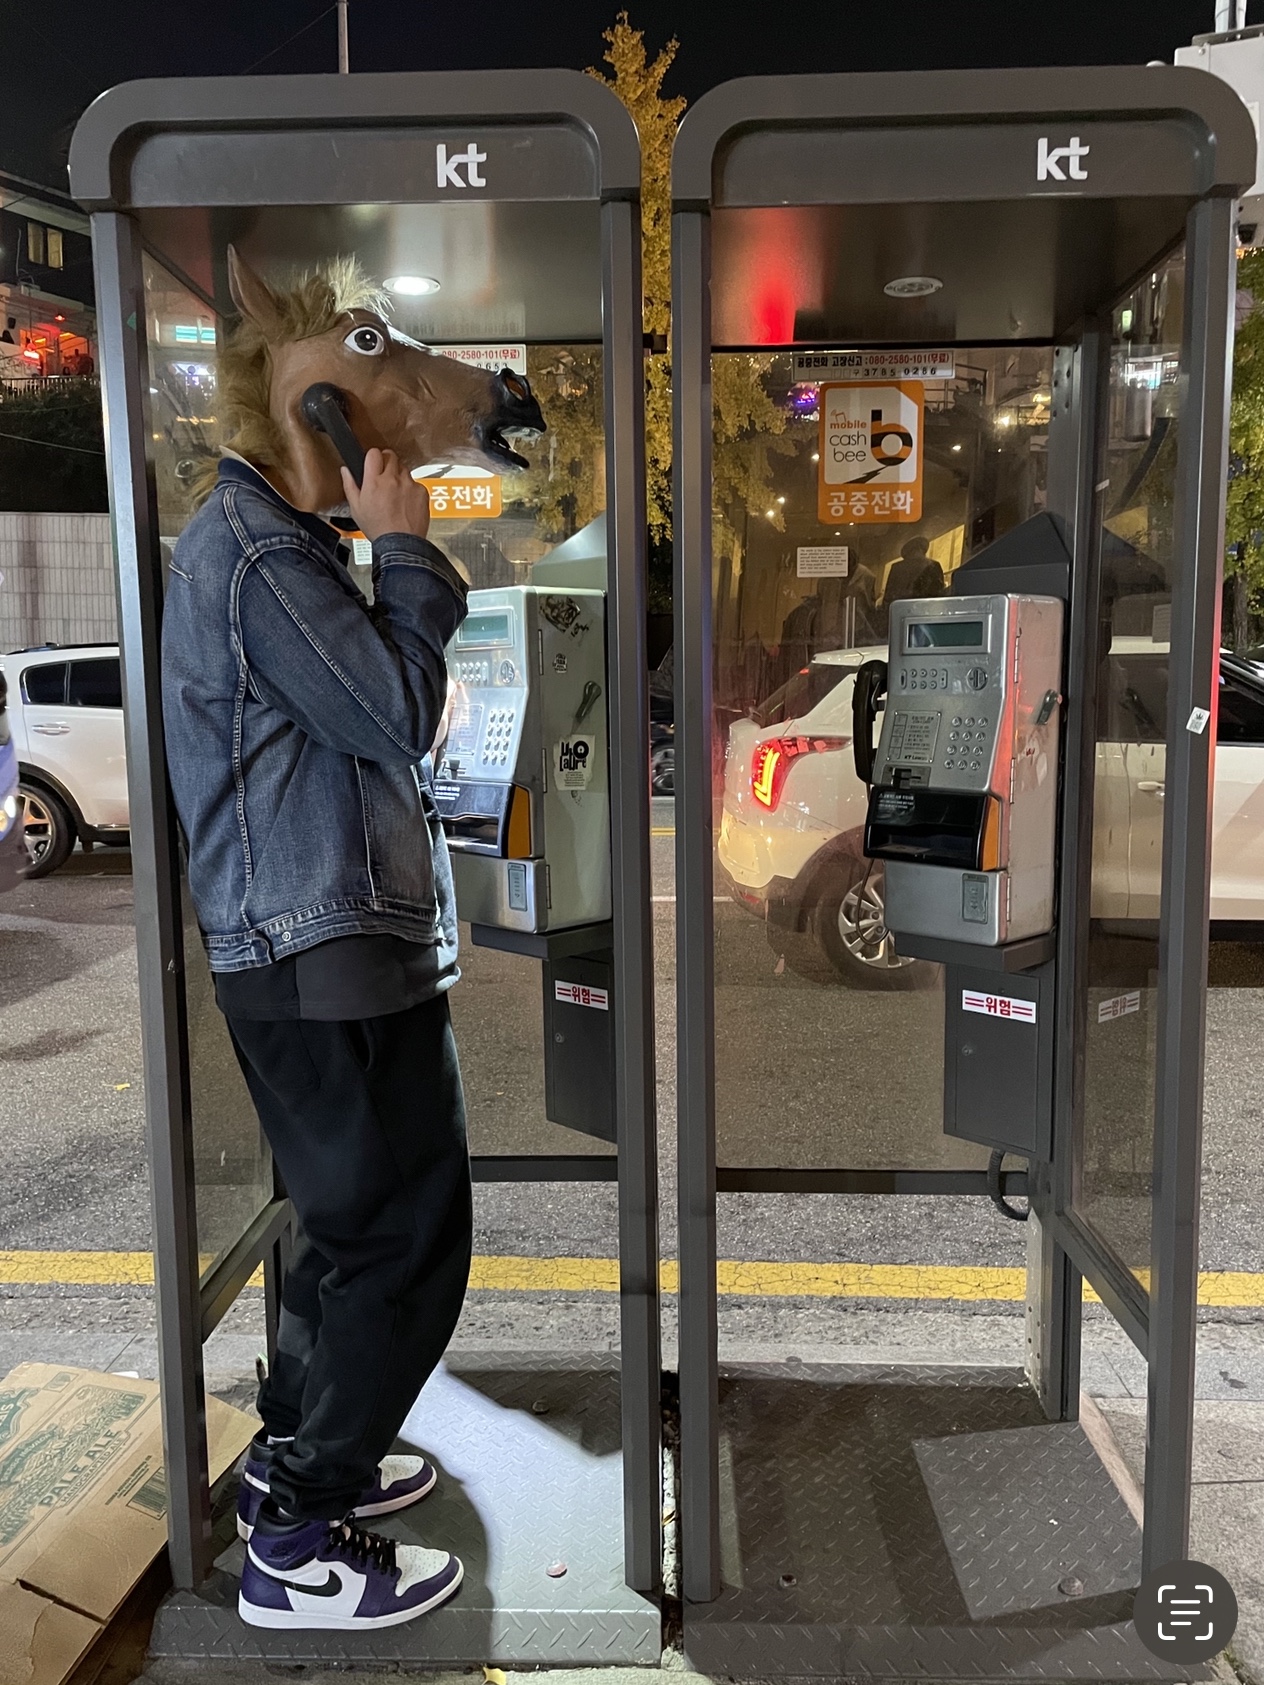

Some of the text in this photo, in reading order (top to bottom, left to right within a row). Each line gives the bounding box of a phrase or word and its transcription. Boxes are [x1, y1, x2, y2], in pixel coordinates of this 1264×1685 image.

[436, 143, 487, 188] kt
[1037, 136, 1090, 181] kt
[797, 356, 828, 368] 공중전화
[832, 355, 863, 367] 고장신고
[829, 420, 867, 430] mobile
[829, 430, 867, 446] cash
[833, 447, 867, 463] bee
[827, 490, 914, 517] 공중전화
[571, 985, 590, 1004] 위험
[985, 996, 1012, 1017] 위험
[38, 1429, 121, 1508] PALE ALE
[60, 1451, 111, 1502] HANDCRAFTED
